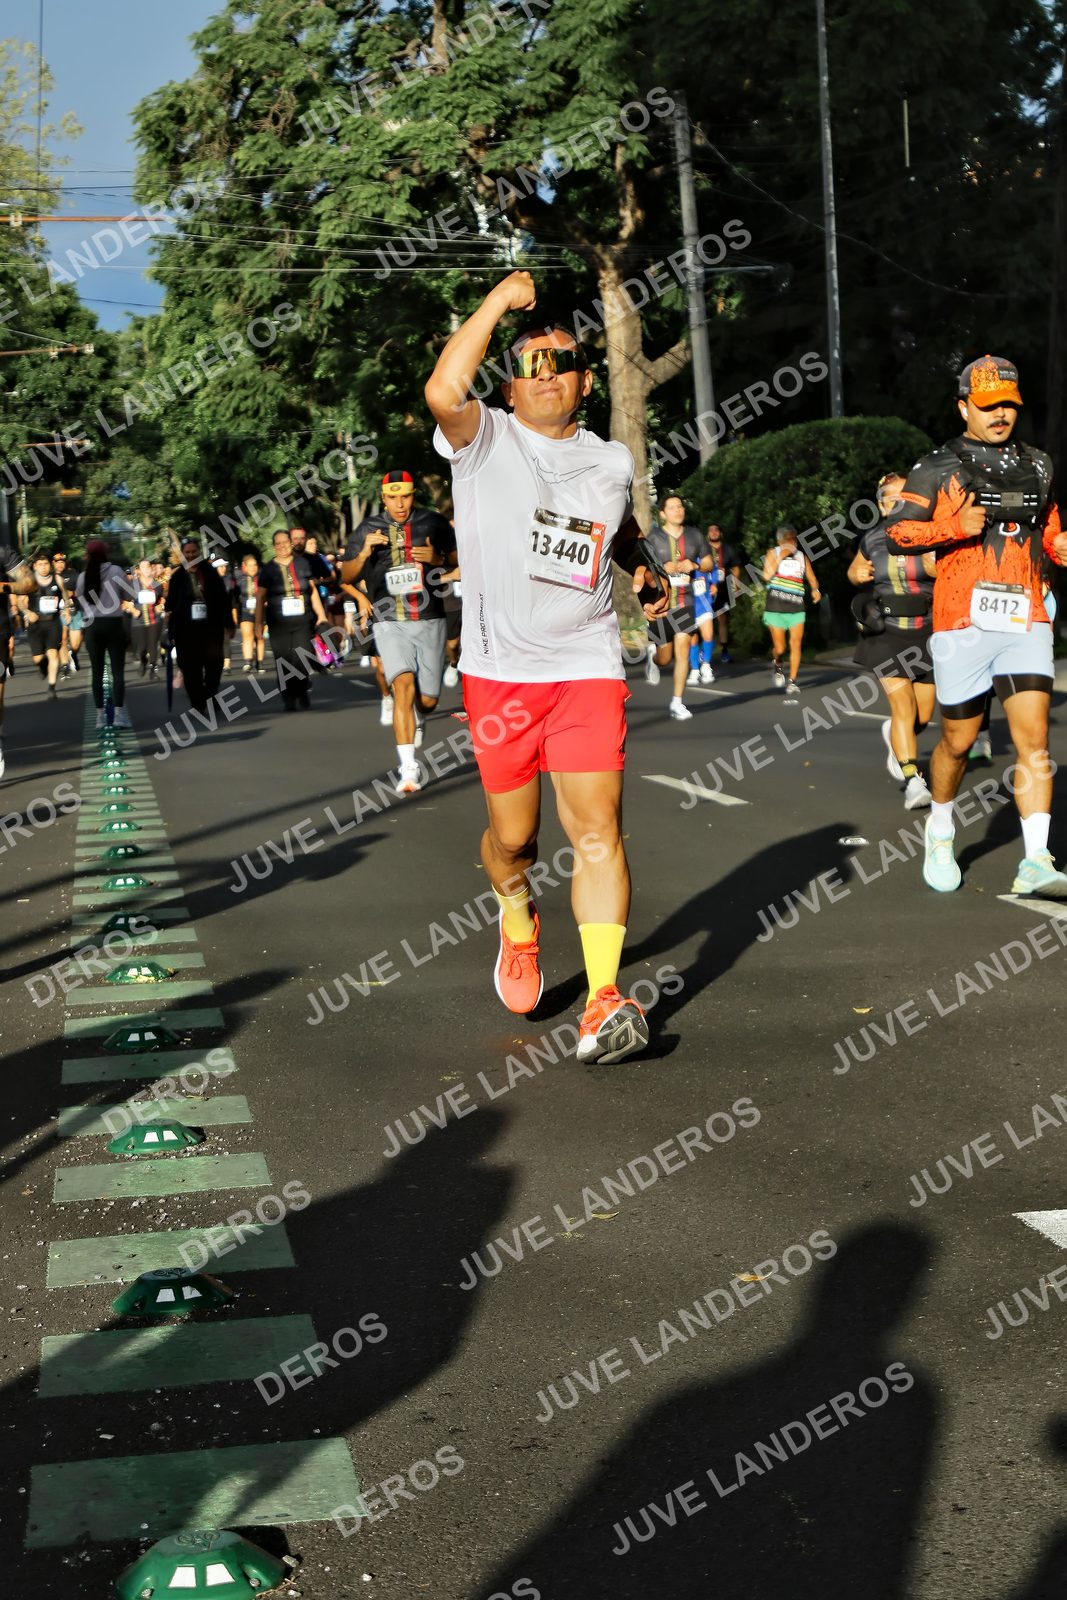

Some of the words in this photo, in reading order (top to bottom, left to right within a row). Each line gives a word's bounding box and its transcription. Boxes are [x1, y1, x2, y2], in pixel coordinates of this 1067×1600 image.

[531, 530, 590, 565] 13440
[389, 571, 418, 585] 12187
[979, 596, 1019, 615] 8412
